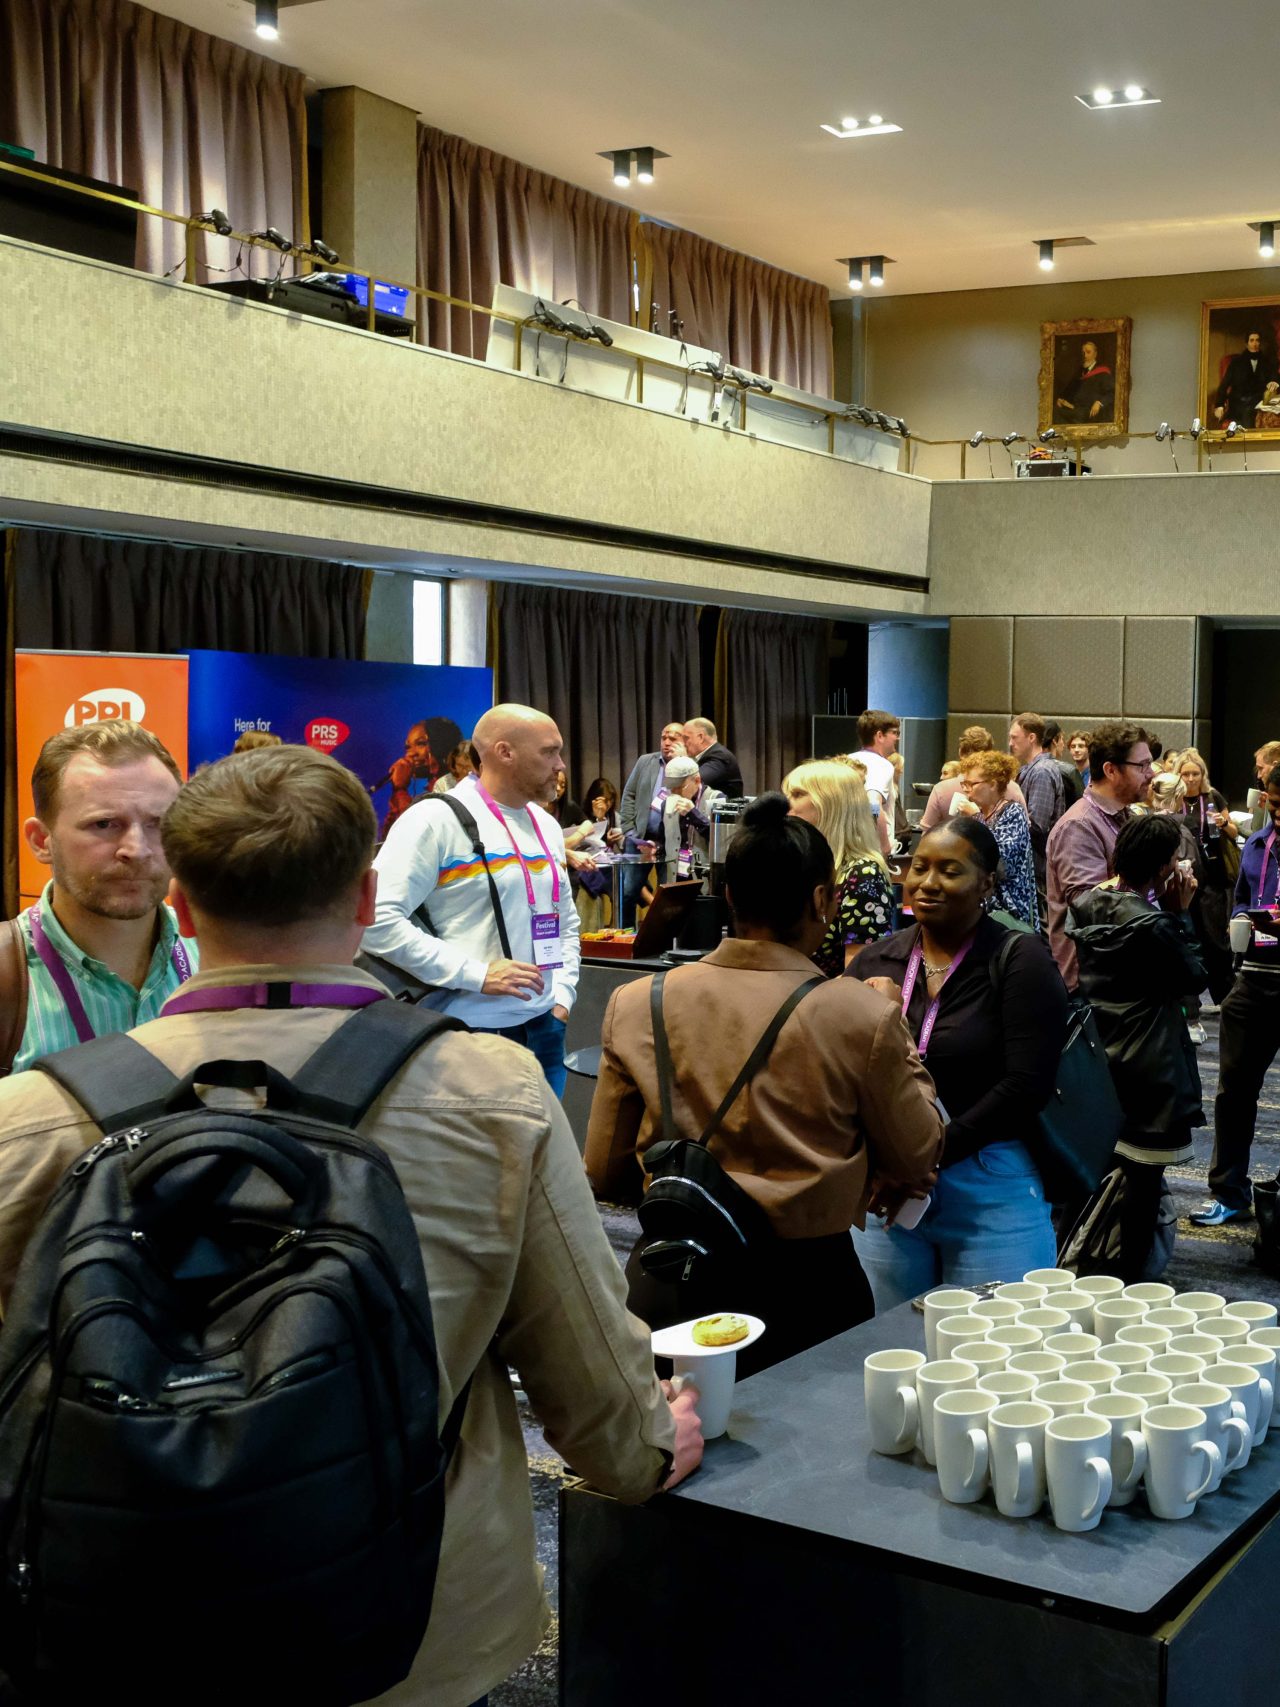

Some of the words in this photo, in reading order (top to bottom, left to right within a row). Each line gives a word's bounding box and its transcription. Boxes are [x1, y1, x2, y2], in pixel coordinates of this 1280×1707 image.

[234, 718, 255, 732] Here
[257, 718, 272, 732] for
[311, 725, 338, 739] PRS
[536, 921, 556, 930] Festival
[175, 942, 189, 974] ACADE
